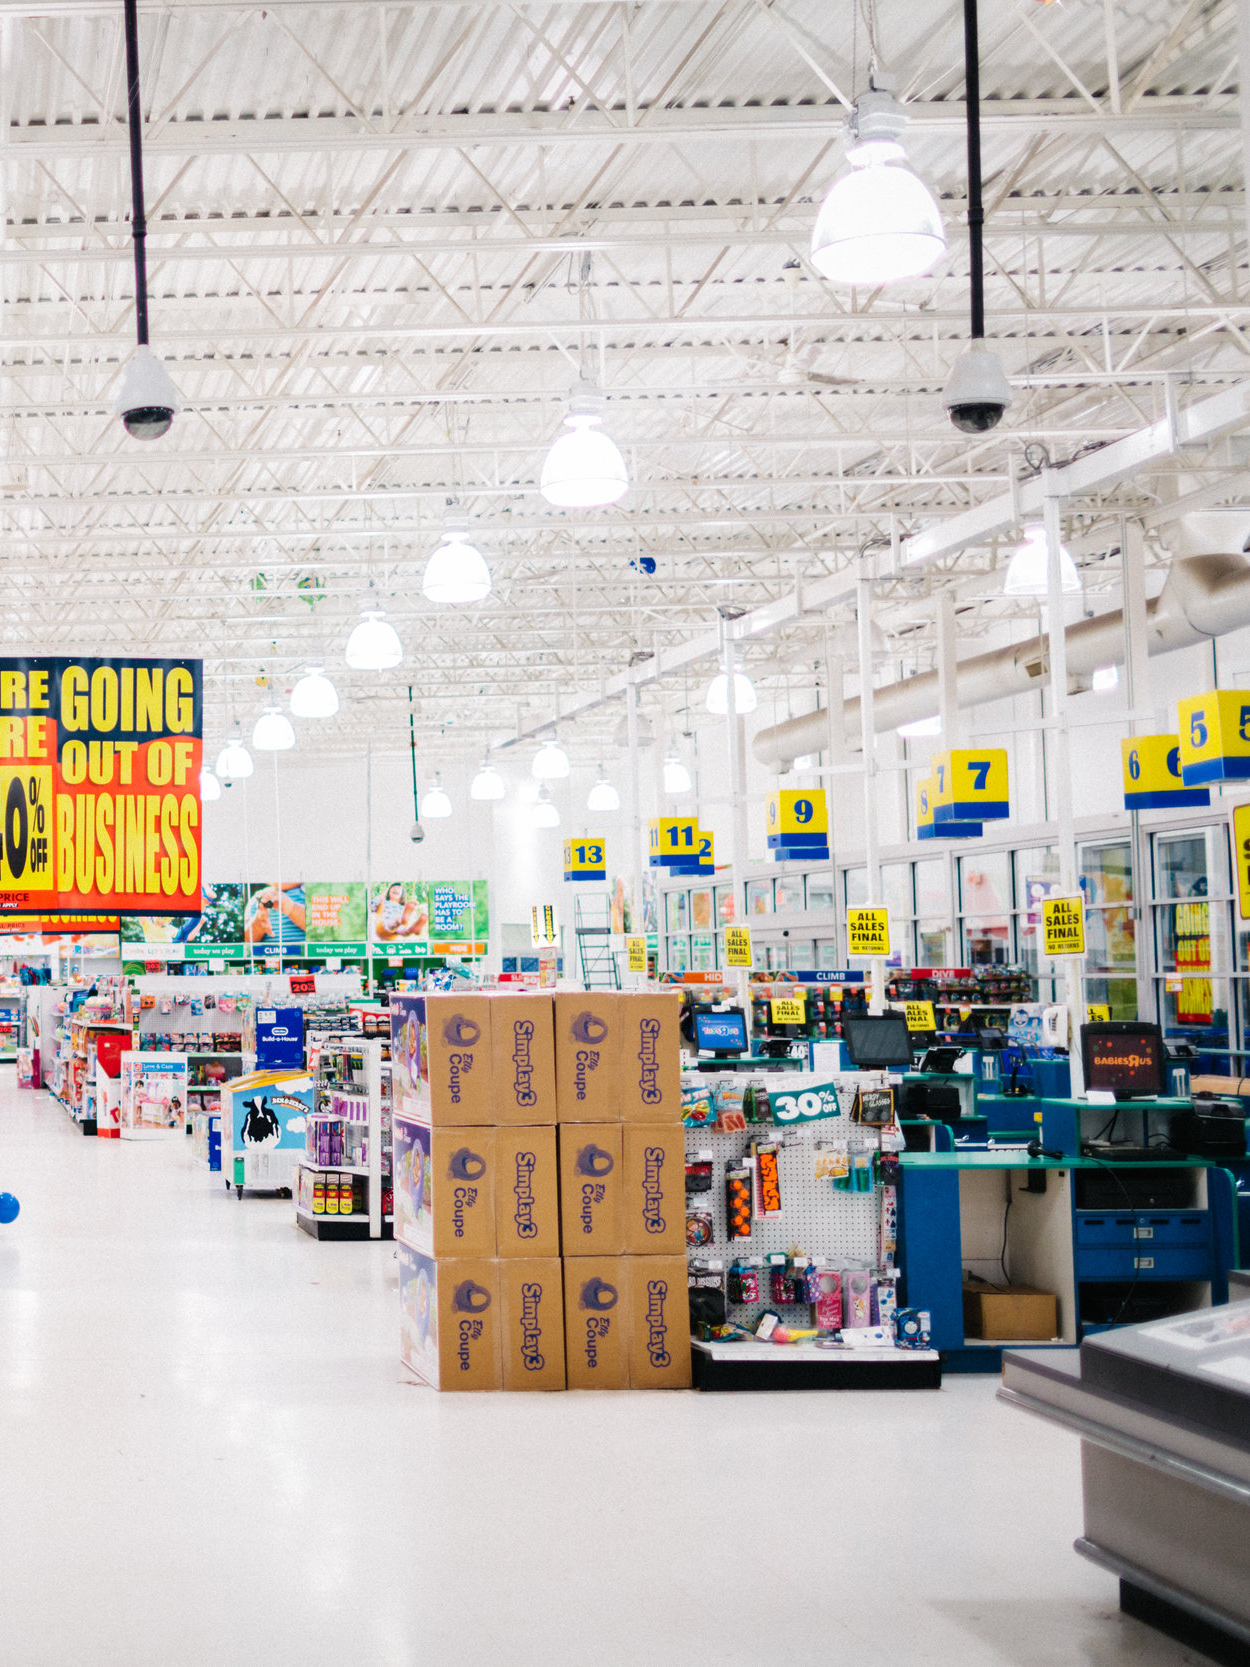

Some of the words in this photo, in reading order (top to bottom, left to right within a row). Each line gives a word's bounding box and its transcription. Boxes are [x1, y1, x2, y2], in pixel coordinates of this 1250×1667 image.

[61, 666, 194, 732] GOING
[1190, 710, 1208, 748] 5
[61, 740, 137, 785] OUT
[147, 741, 193, 785] OF
[1128, 750, 1141, 781] 6
[936, 764, 945, 793] 7
[967, 761, 991, 790] 7
[794, 799, 814, 824] 9
[920, 789, 928, 815] 8
[770, 801, 776, 825] 9
[57, 792, 198, 896] BUSINESS
[650, 827, 659, 848] 11
[666, 826, 694, 847] 11
[30, 837, 48, 874] OFF
[564, 846, 571, 865] 13
[575, 845, 603, 864] 13
[699, 838, 712, 857] 2
[857, 912, 877, 922] ALL
[1053, 903, 1072, 914] ALL
[850, 922, 885, 931] SALES
[1046, 914, 1080, 927] SALES
[852, 932, 884, 942] FINAL
[1047, 927, 1080, 939] FINAL
[222, 948, 235, 956] play
[344, 947, 357, 955] play
[1057, 942, 1080, 950] RETURNS
[1178, 939, 1197, 962] OUT
[704, 973, 722, 982] HID
[816, 972, 846, 980] CLIMB
[932, 970, 955, 978] DIVE
[462, 1053, 474, 1074] Elly
[512, 1020, 537, 1107] Simplay3
[587, 1050, 600, 1071] Elly
[637, 1018, 662, 1105] Simplay3
[448, 1053, 461, 1104] Coupe
[575, 1049, 587, 1101] Coupe
[822, 1103, 837, 1113] OFF
[869, 1098, 890, 1108] GLASSES
[466, 1187, 478, 1208] Elly
[513, 1152, 538, 1239] Simplay3
[594, 1183, 606, 1204] Elly
[642, 1147, 666, 1234] Simplay3
[453, 1187, 465, 1238] Coupe
[581, 1183, 593, 1235] Coupe
[471, 1320, 484, 1341] Elly
[520, 1283, 545, 1372] Simplay3
[598, 1317, 610, 1338] Elly
[645, 1280, 671, 1368] Simplay3
[458, 1320, 470, 1372] Coupe
[585, 1317, 597, 1368] Coupe
